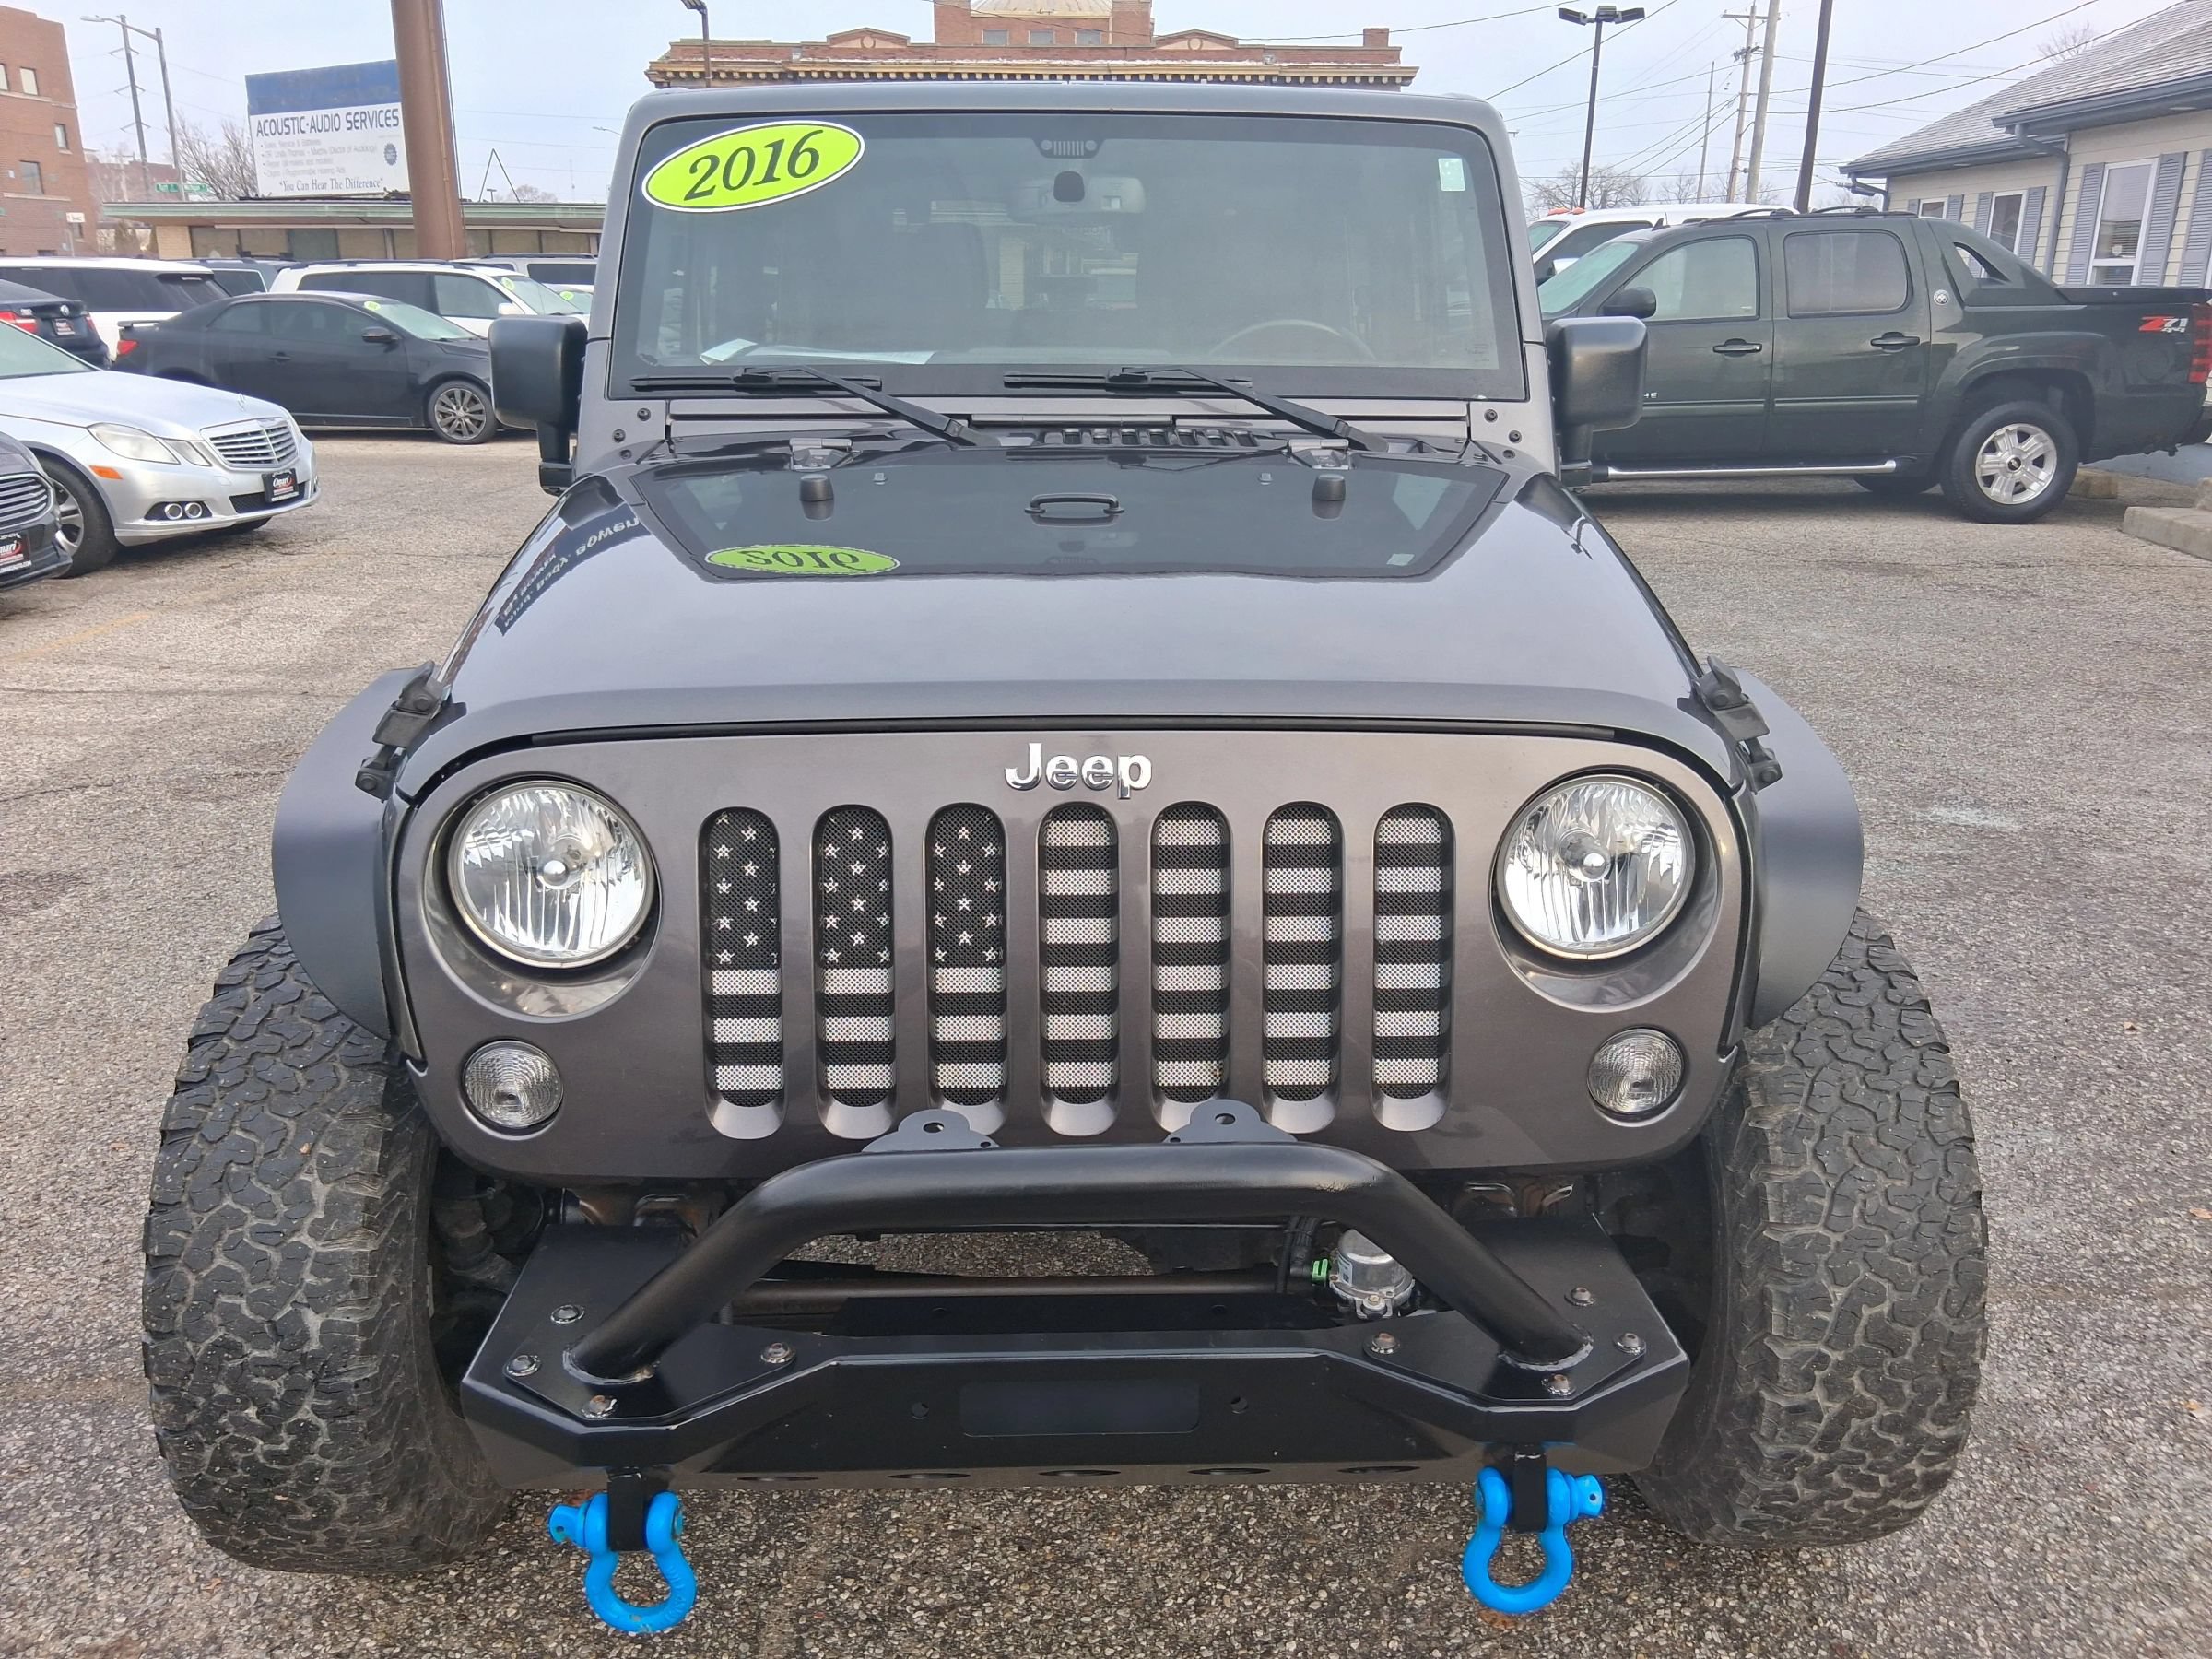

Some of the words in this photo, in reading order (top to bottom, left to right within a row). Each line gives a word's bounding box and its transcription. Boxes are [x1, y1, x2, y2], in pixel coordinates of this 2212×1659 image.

[346, 108, 399, 131] SERVICES
[683, 130, 824, 201] 2016
[296, 180, 310, 191] Can
[312, 179, 327, 191] Hear
[329, 178, 343, 190] The
[2139, 315, 2189, 331] Z71
[1005, 743, 1152, 800] Jeep
